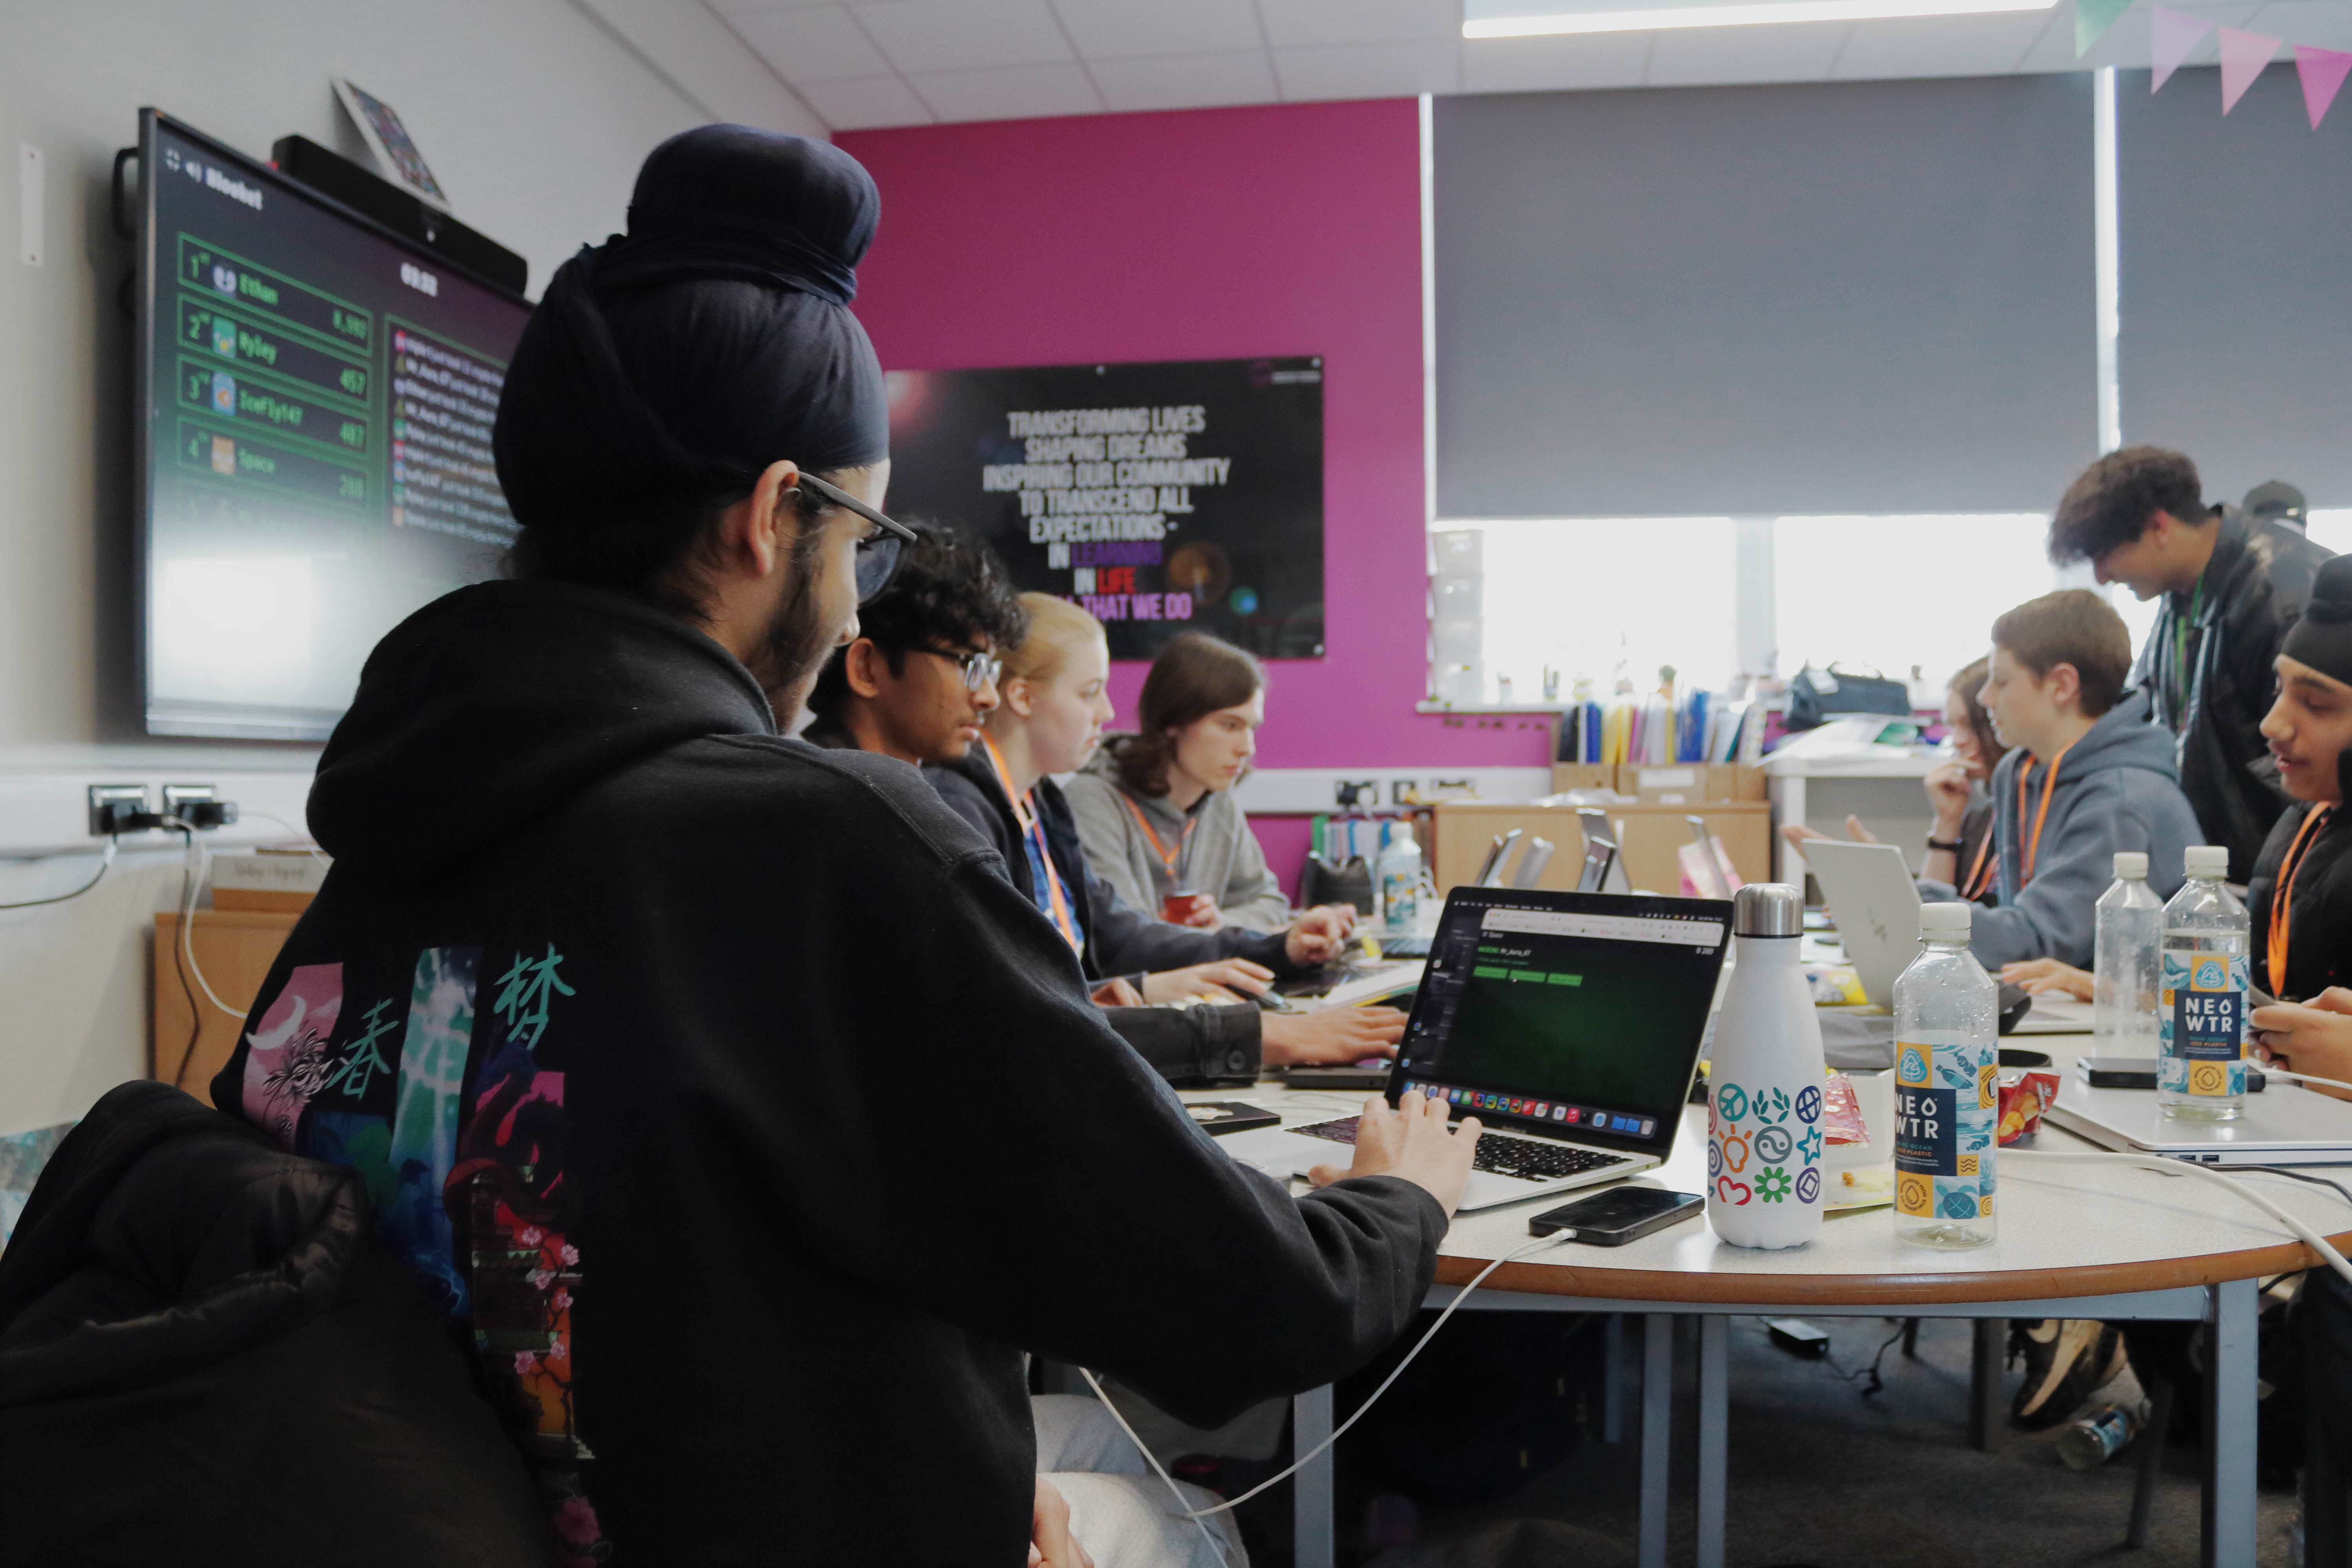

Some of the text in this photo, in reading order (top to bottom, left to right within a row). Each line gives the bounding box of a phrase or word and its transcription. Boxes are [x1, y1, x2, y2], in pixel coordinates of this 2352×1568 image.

[1007, 406, 1205, 438] TRANSFORMING LIVES
[1025, 433, 1187, 463] SHAPING DREAMS
[983, 457, 1231, 492] INSPIRING OUR COMMUNITY
[1019, 486, 1194, 517] TO TRANSCEND ALL
[1029, 514, 1166, 543] EXPECTATIONS
[1048, 542, 1070, 569] IN
[1074, 566, 1136, 595] IN LIFE
[1081, 592, 1192, 621] THAT WE DO
[2185, 998, 2232, 1014] NEO
[2185, 1015, 2232, 1032] WTR
[1895, 1114, 1938, 1138] WTR
